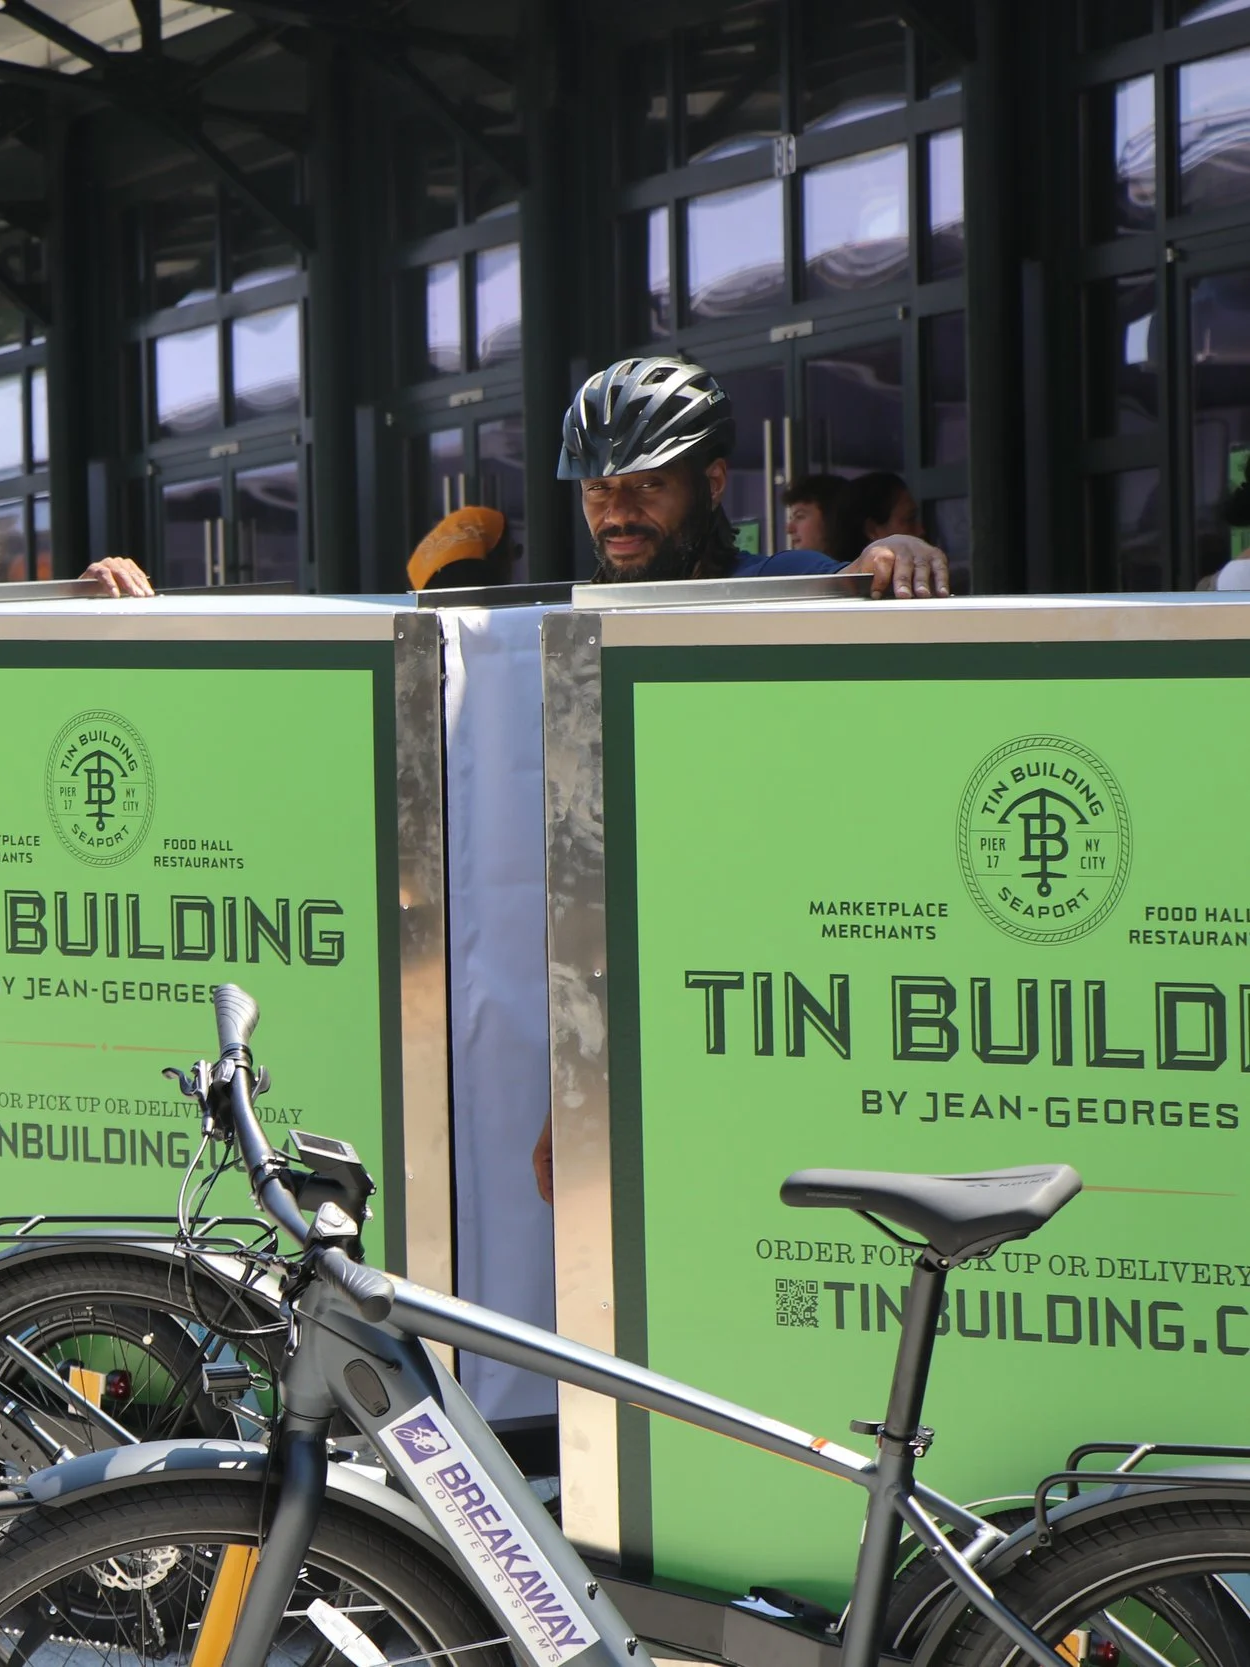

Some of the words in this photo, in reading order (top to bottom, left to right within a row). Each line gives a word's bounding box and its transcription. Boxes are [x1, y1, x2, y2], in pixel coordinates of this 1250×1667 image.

[60, 744, 78, 770] TIN
[79, 730, 138, 772] BUILDING
[60, 787, 76, 797] PIER
[126, 788, 136, 799] NY
[981, 780, 1009, 816] TIN
[1010, 762, 1104, 817] BUILDING
[64, 800, 72, 810] 17
[123, 801, 139, 811] CITY
[71, 823, 130, 848] SEAPORT
[980, 837, 1006, 851] PIER
[163, 839, 197, 851] FOOD
[201, 840, 233, 852] HALL
[1085, 839, 1100, 852] NY
[153, 856, 244, 870] RESTAURANTS
[986, 855, 999, 868] 17
[1080, 856, 1105, 870] CITY
[809, 900, 948, 918] MARKETPLACE
[997, 886, 1089, 919] SEAPORT
[1145, 906, 1197, 922] FOOD
[4, 889, 345, 967] BUILDING
[821, 924, 936, 940] MERCHANTS
[1129, 929, 1250, 946] RESTAURAN
[684, 970, 851, 1060] TIN
[26, 1093, 73, 1111] PICK
[76, 1096, 100, 1112] UP
[104, 1097, 131, 1116] OR
[862, 1089, 908, 1115] BY
[918, 1091, 1239, 1129] JEAN-GEORGES
[755, 1239, 855, 1264] ORDER
[860, 1244, 916, 1266] FOR
[1001, 1251, 1041, 1274] UP
[1048, 1254, 1089, 1278] OR
[437, 1461, 586, 1648] BREAKAWAY
[425, 1475, 491, 1564] COURIER
[493, 1573, 561, 1664] SYSTEMS
